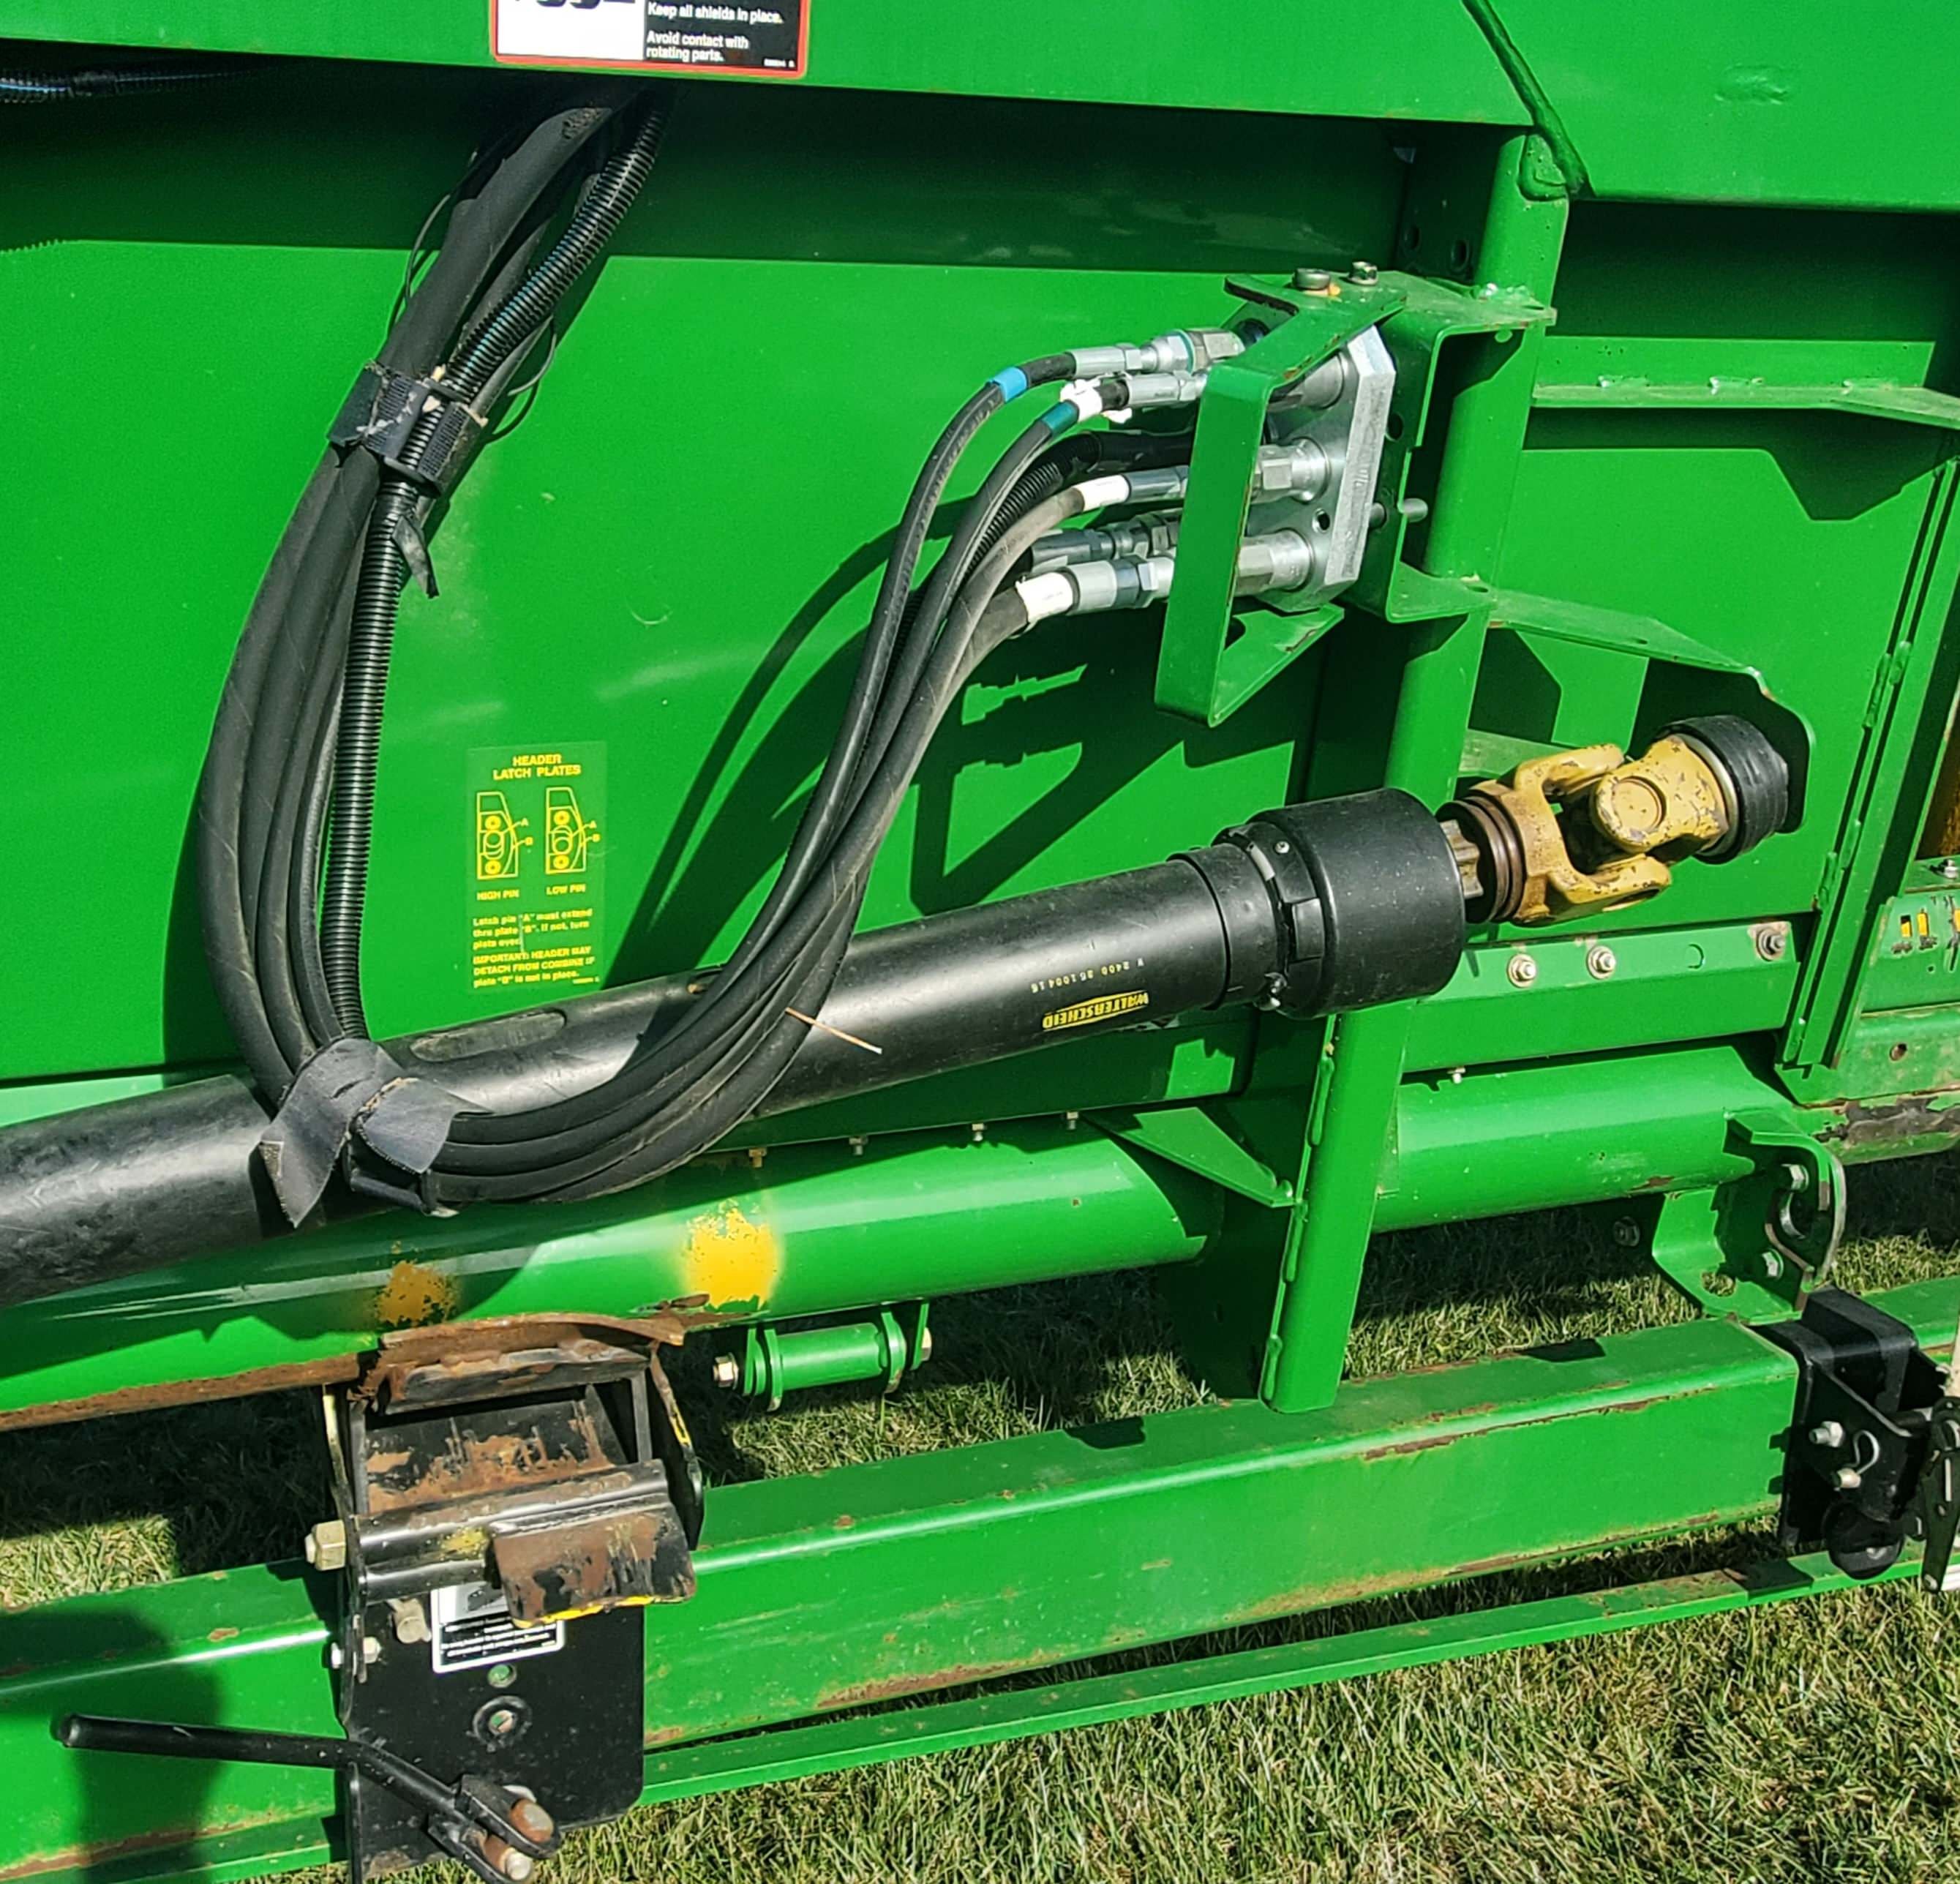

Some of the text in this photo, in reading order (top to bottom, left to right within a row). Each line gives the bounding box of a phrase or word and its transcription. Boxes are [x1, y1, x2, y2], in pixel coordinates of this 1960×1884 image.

[647, 1, 784, 25] Keep all shields in place.
[647, 30, 749, 49] Avoid contact with
[646, 46, 724, 62] rotating parts.
[513, 754, 562, 766] HEADER
[492, 765, 581, 781] LATCH PLATES
[521, 817, 529, 826] A
[589, 820, 597, 829] A
[477, 889, 519, 901] HIGH PIN
[546, 884, 586, 896] LOW PIN
[473, 916, 499, 926] Latch
[473, 946, 592, 964] IMPORTANT: HEADER MAY
[473, 964, 511, 976] DETACH
[513, 961, 539, 972] FROM
[541, 958, 584, 969] COMBINE
[1101, 961, 1130, 975] 2400
[1043, 992, 1149, 1029] WALTERSCHEID
